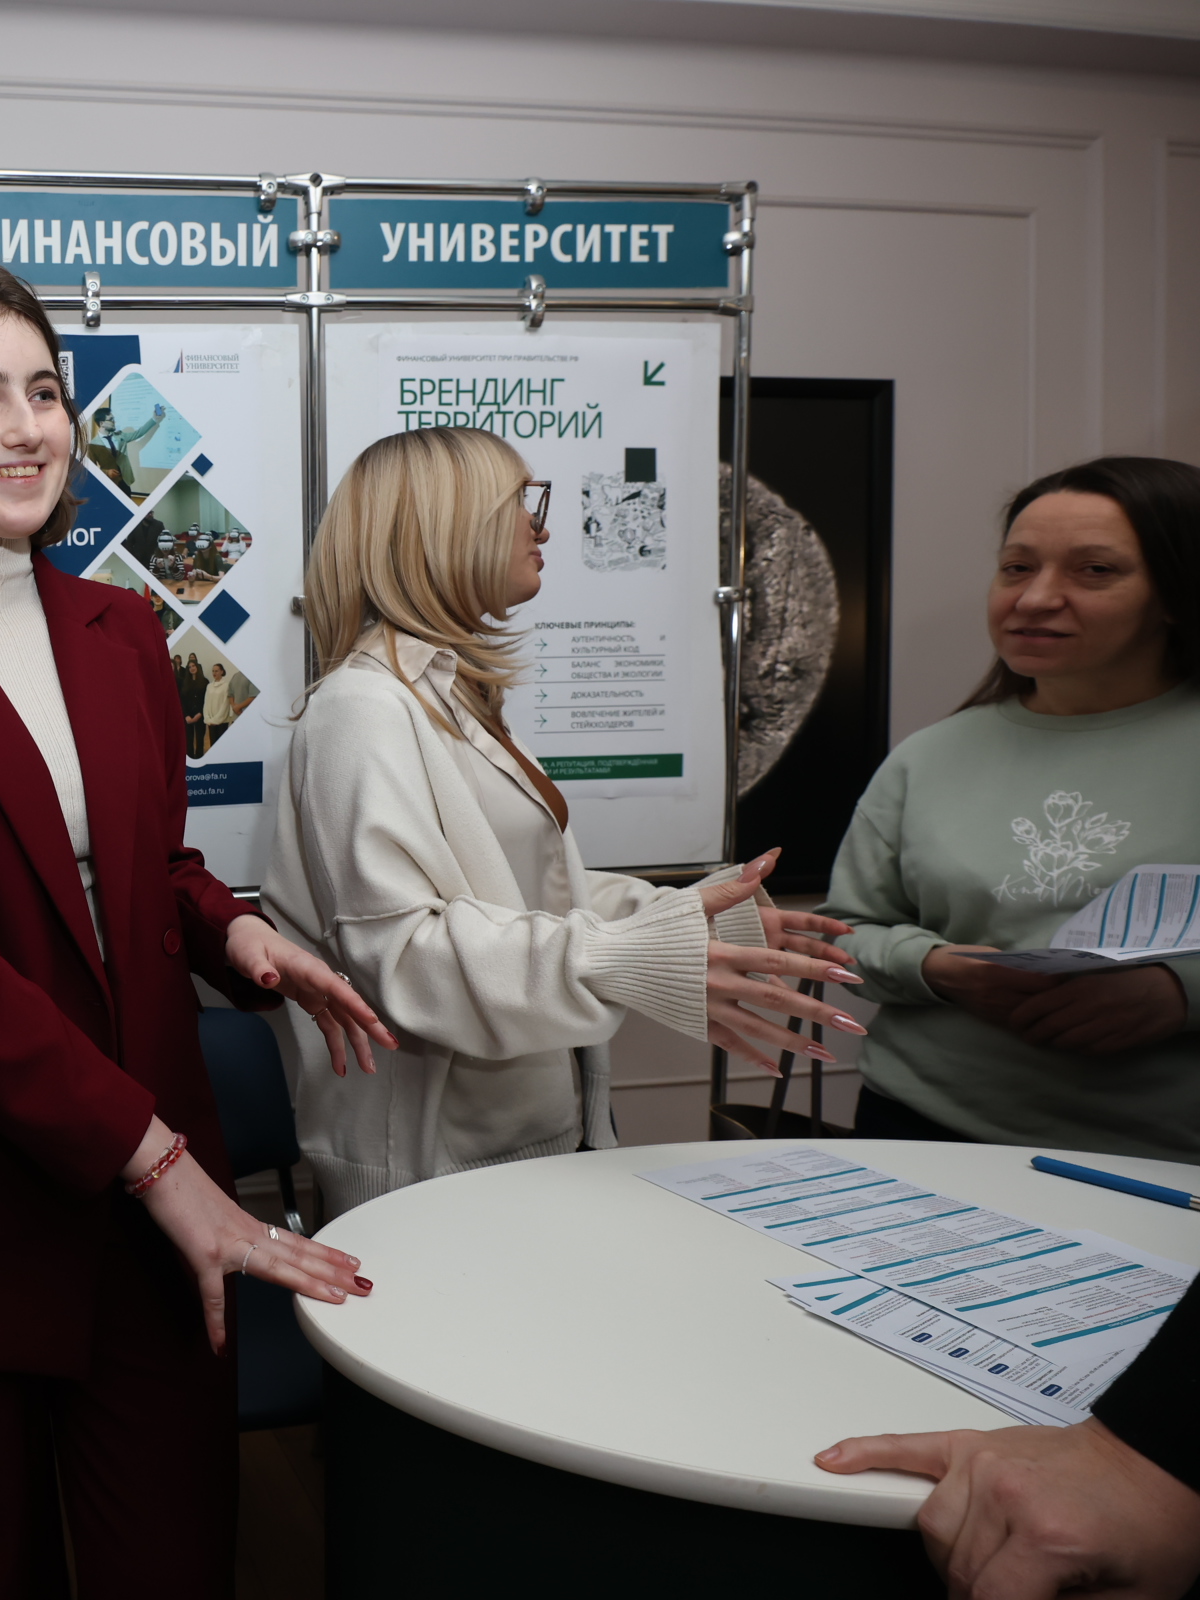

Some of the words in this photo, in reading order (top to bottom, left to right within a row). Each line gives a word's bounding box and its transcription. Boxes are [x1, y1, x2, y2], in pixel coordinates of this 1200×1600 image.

[380, 222, 675, 263] УНИВЕРСИТЕТ
[185, 353, 240, 362] ФИНАНСОВЫЙ
[396, 354, 447, 362] ФИНАНСОВЫЙ
[185, 362, 240, 370] УНИВЕРСИТЕТ
[399, 378, 565, 413] БРЕНДИНГ
[397, 403, 603, 438] ТЕРРИТОРИЙ
[47, 527, 102, 547] ЛОГ
[535, 621, 582, 630] КЛЮЧЕВЫЕ
[583, 621, 636, 630] ПРИНЦИПЫ:
[571, 634, 636, 643] АУТЕНТИЧНОСТЬ
[571, 644, 622, 654] КУЛЬТУРНЫЙ
[614, 660, 666, 668] ЭКОНОМИКИ,
[571, 671, 612, 680] ОБЩЕСТВА
[571, 690, 644, 699] ДОКАЗАТЕЛЬНОСТЬ
[571, 710, 620, 718] ВОВЛЕЧЕНИЕ
[622, 708, 658, 717] ЖИТЕЛЕЙ
[571, 720, 634, 729] СТЕЙКХОЛДЕРОВ
[187, 788, 224, 796] @edu.fa.ru
